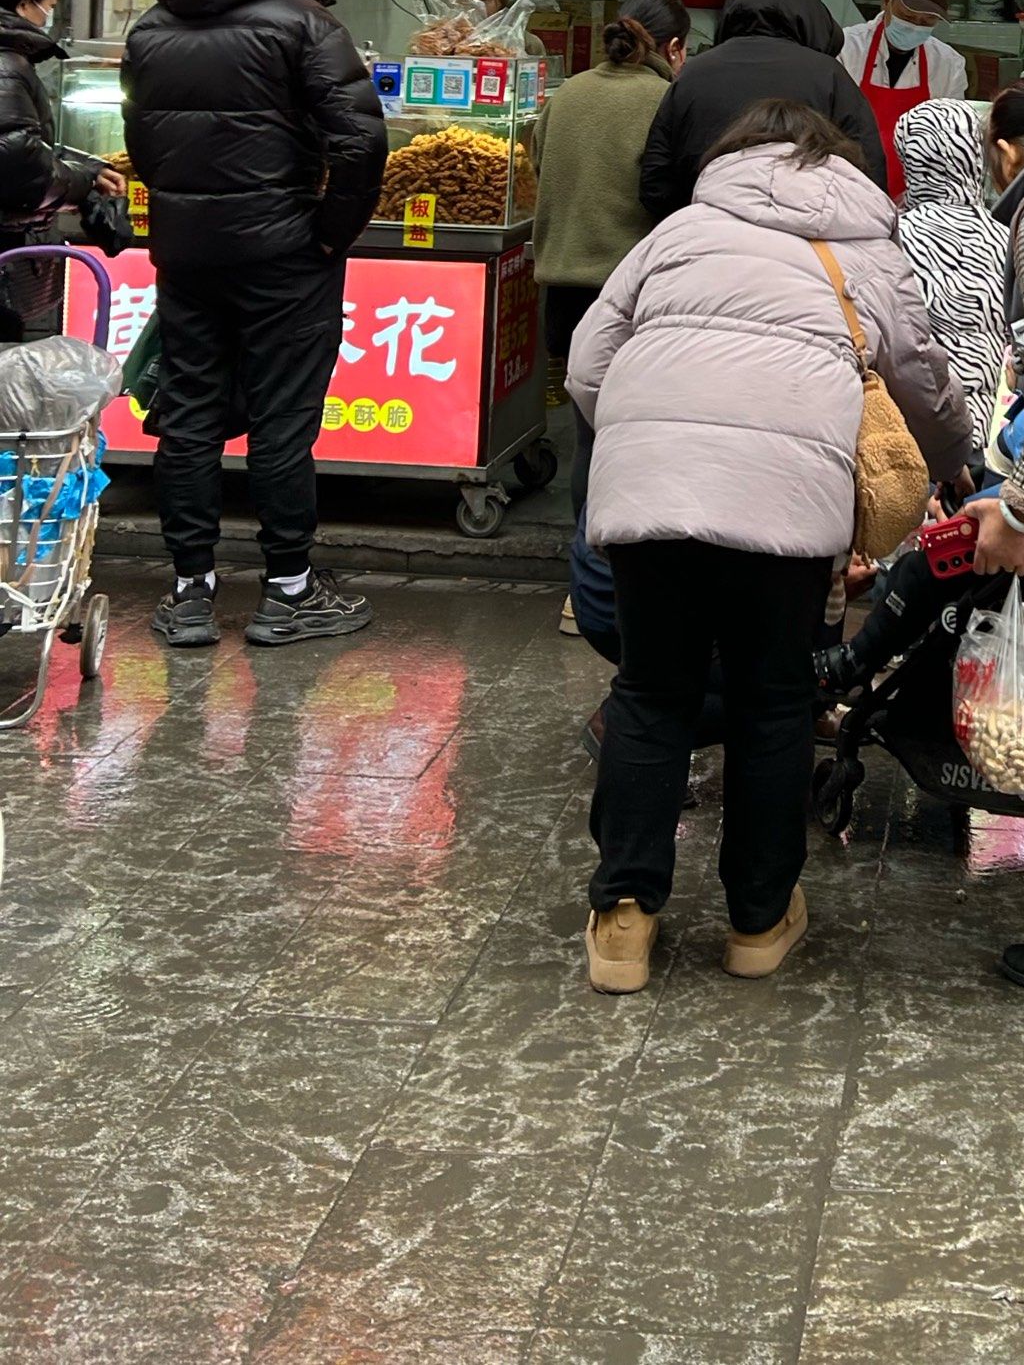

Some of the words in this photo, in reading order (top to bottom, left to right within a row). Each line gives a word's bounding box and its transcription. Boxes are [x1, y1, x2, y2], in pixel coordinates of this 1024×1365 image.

[133, 186, 149, 230] 甜味
[410, 198, 430, 243] 椒盐
[324, 402, 409, 429] 香酥脆
[940, 762, 998, 793] SISV
